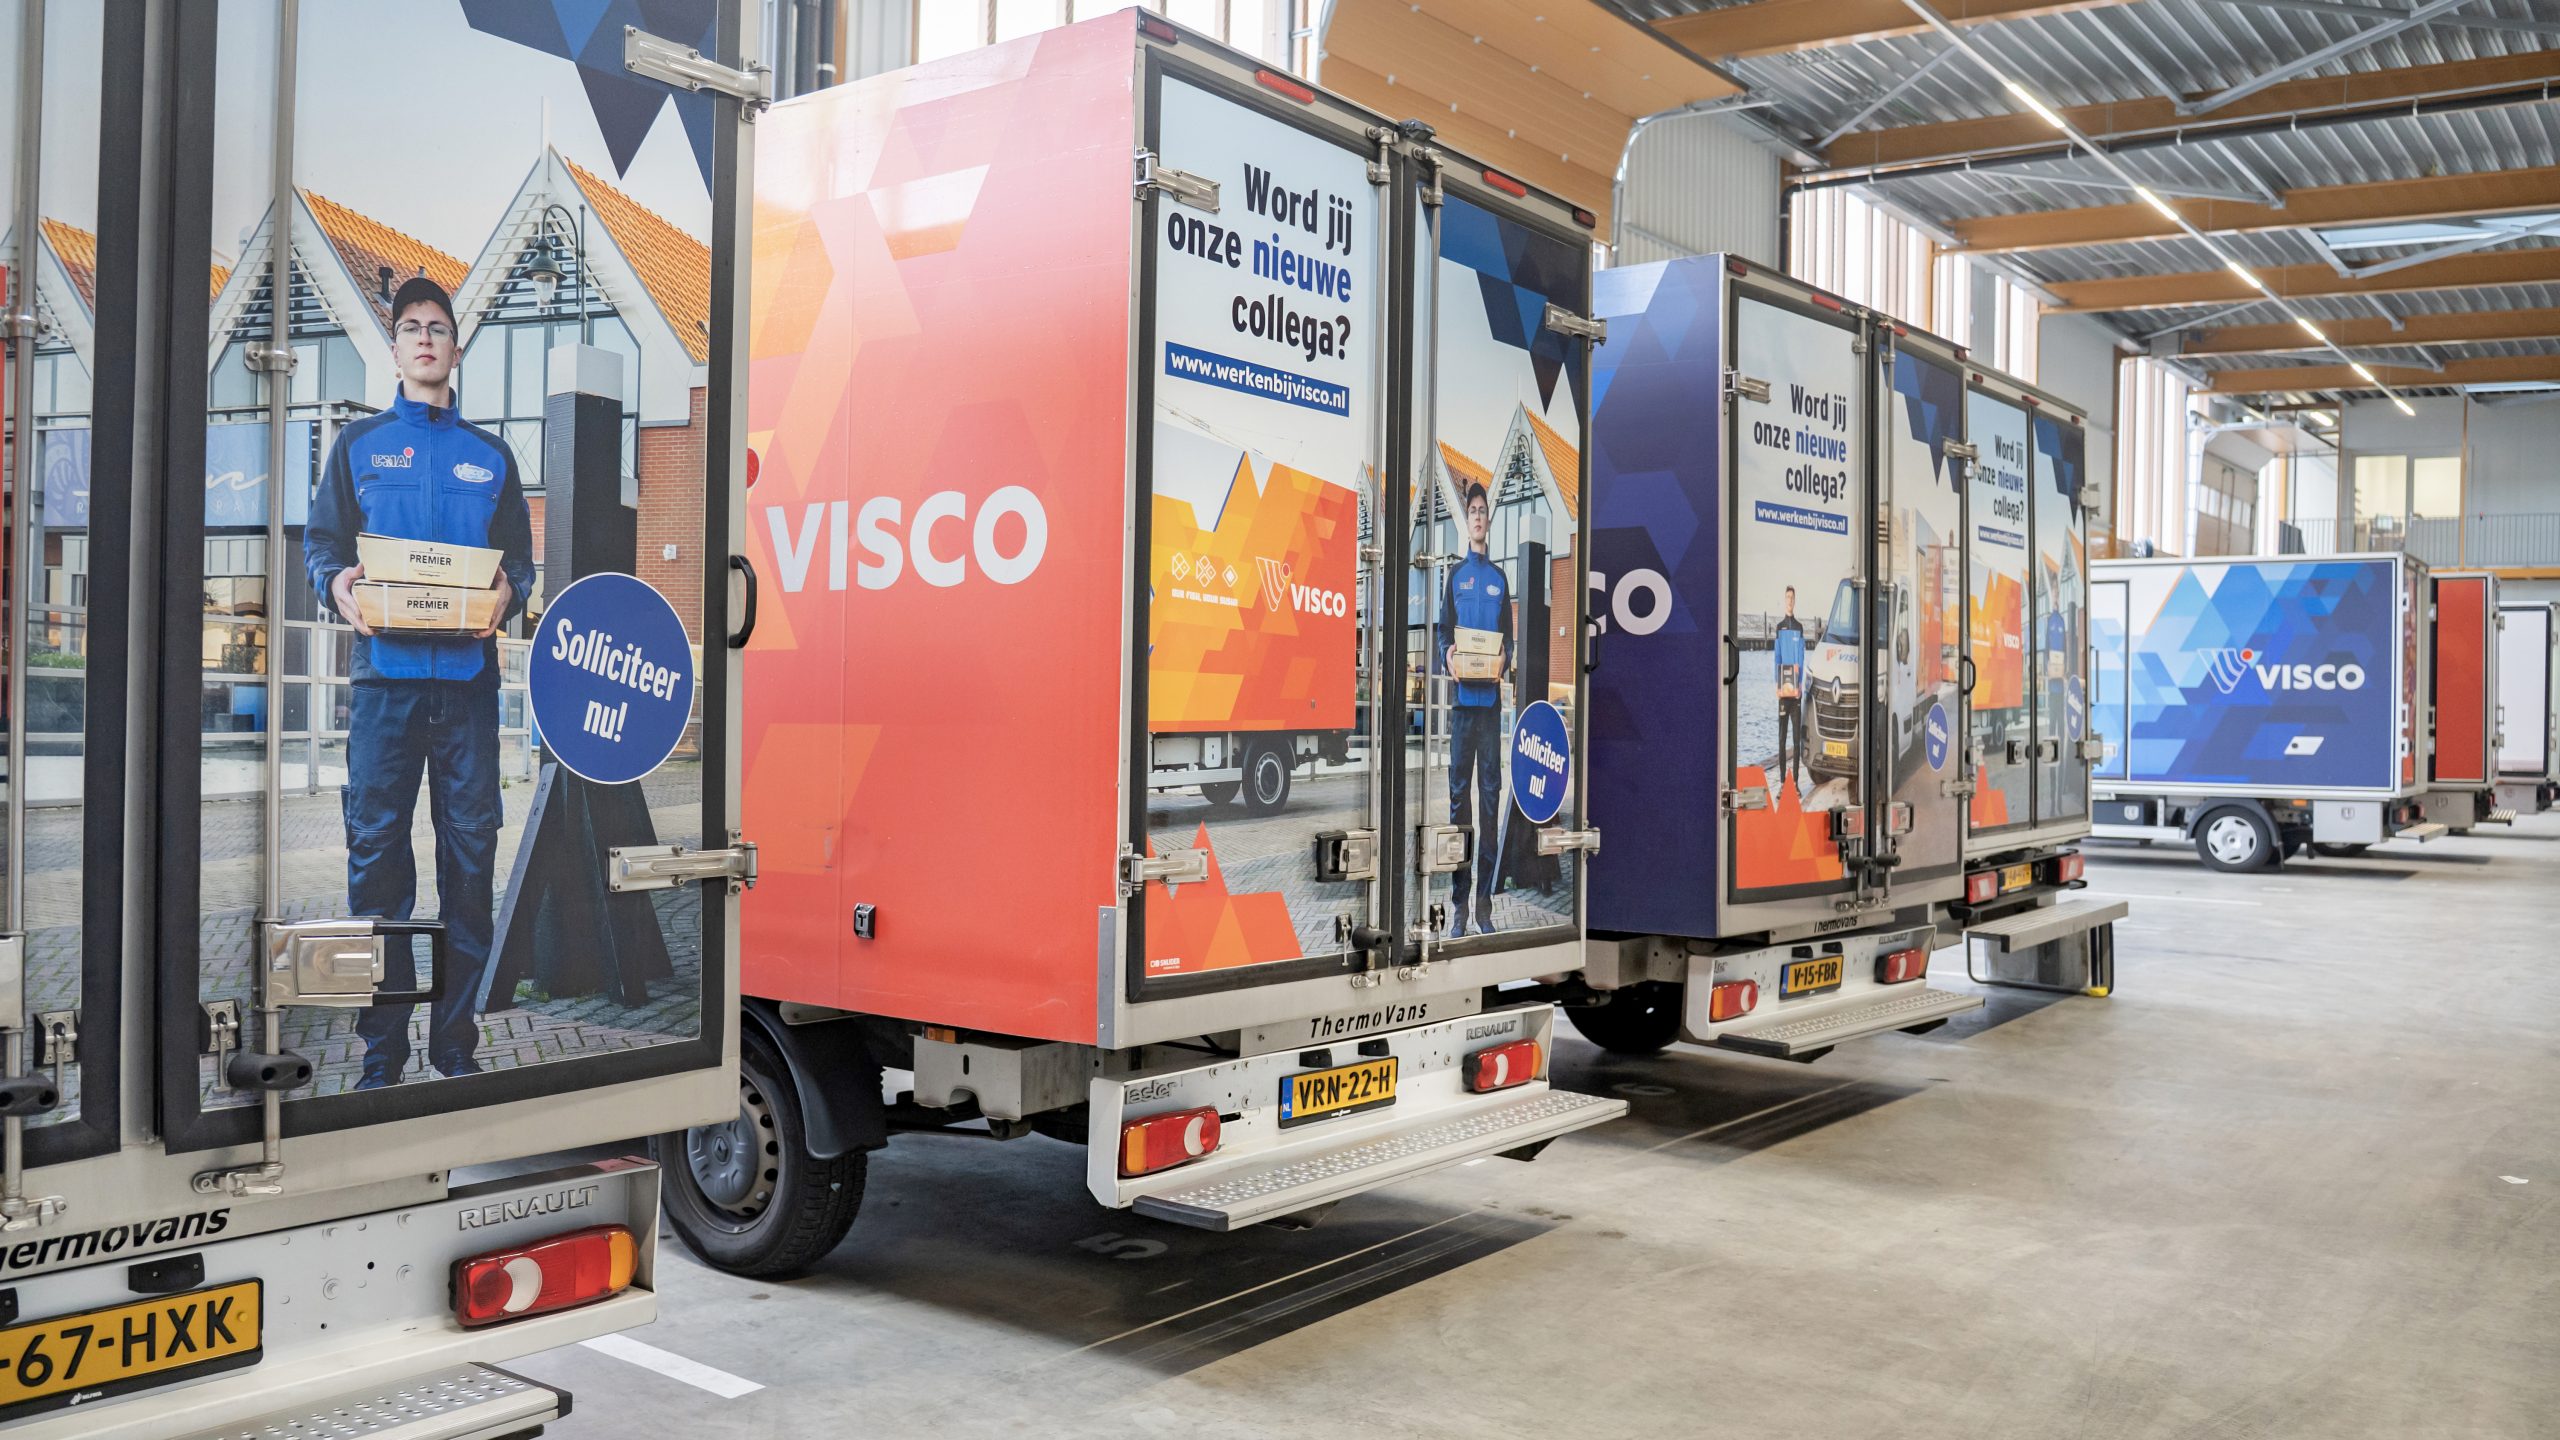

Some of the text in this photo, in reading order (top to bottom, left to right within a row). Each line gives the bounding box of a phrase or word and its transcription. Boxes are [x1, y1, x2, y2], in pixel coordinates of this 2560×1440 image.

[1243, 162, 1352, 256] Word jij
[1167, 212, 1351, 303] onze nieuwe
[1231, 293, 1351, 362] collega?
[1171, 352, 1346, 409] www.werkenbijvisco.nl
[1790, 384, 1846, 432] Word jij
[1754, 421, 1846, 463] onze nieuwe
[1994, 434, 2014, 462] Word
[1786, 463, 1846, 504] collega?
[1998, 465, 2023, 493] nieuwe
[1757, 507, 1845, 531] www.werkenbijvisco.nl
[1993, 495, 2023, 526] collega?
[409, 553, 452, 566] PREMIER
[765, 485, 1048, 593] VISCO
[406, 599, 449, 610] PREMIER
[1290, 583, 1346, 618] VISCO
[552, 618, 681, 701] Solliciteer
[2256, 663, 2365, 690] VISCO
[583, 700, 628, 742] nu!
[1518, 728, 1566, 775] Solliciteer
[1529, 774, 1546, 800] nu!
[1794, 961, 1837, 987] V-15-FBR
[1466, 1019, 1516, 1041] RENAULT
[1282, 1103, 1291, 1112] NL
[1299, 1065, 1390, 1109] VRN-22-H
[459, 1185, 599, 1231] RENAULT
